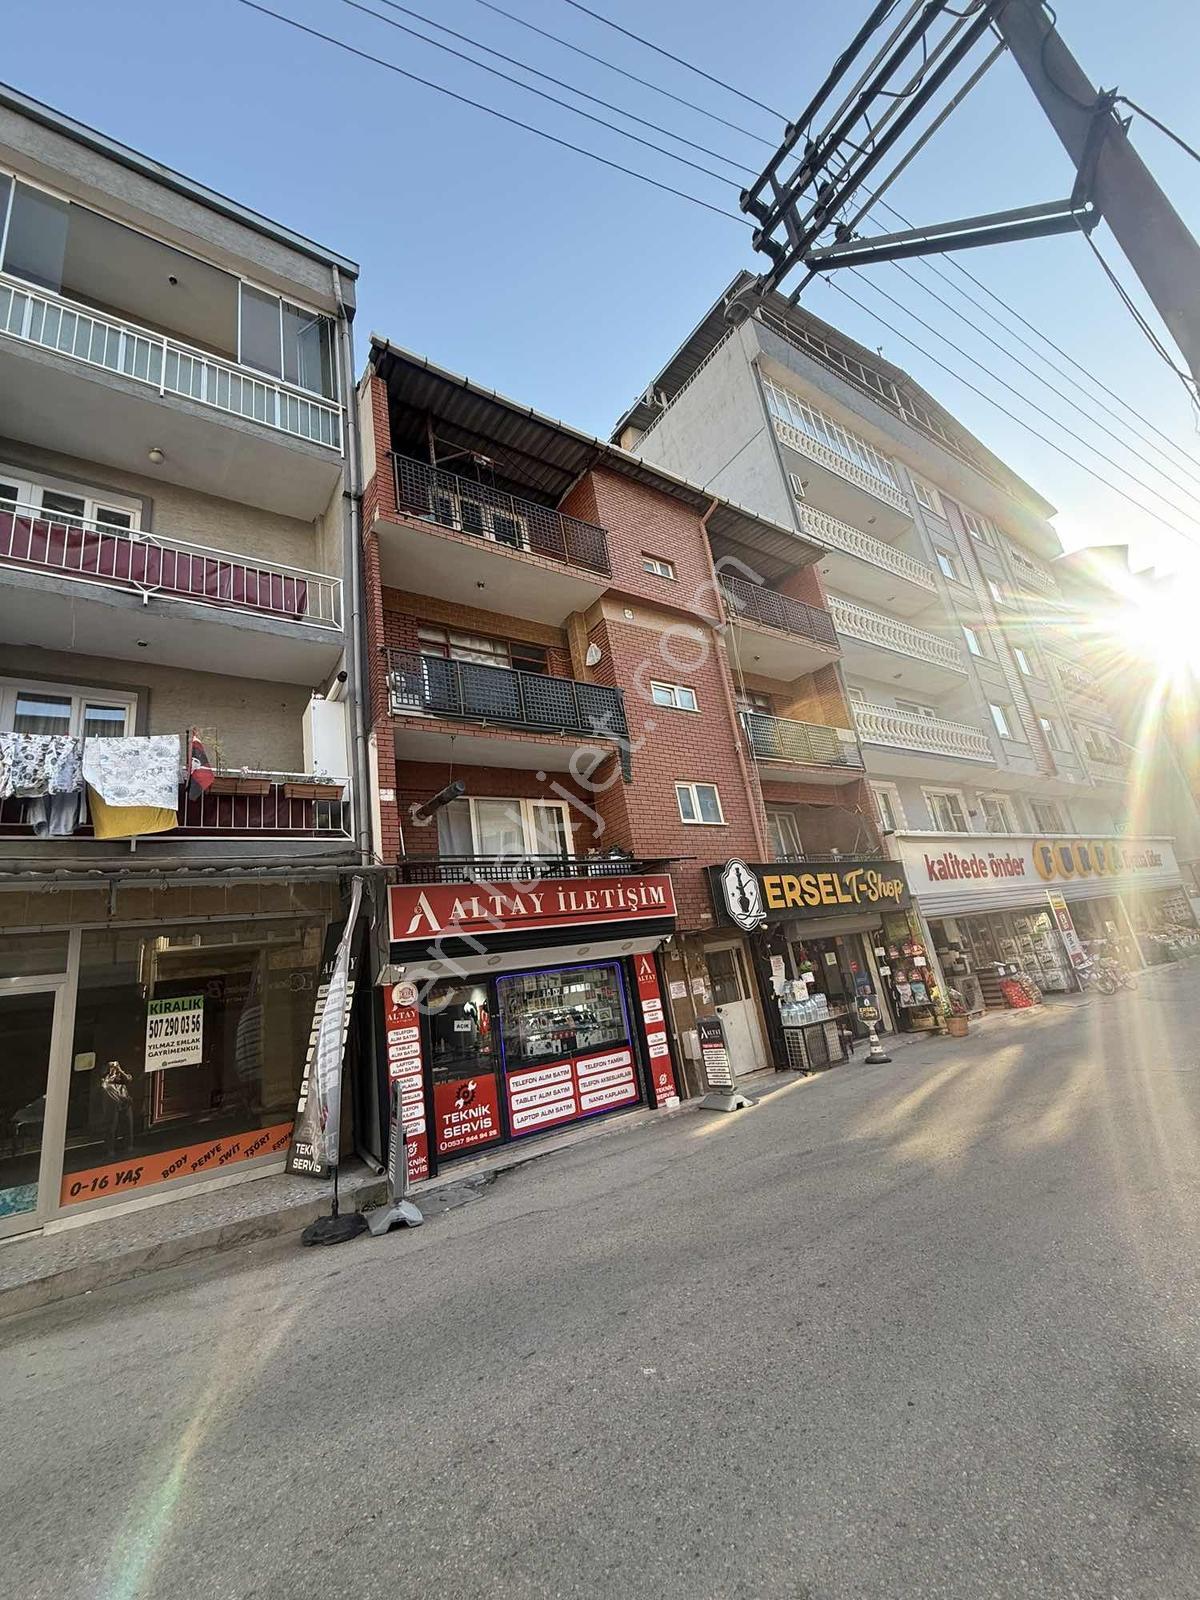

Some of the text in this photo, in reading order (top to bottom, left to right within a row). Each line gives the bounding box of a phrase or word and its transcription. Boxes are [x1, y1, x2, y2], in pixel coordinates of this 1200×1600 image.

[924, 852, 1025, 881] kalitede önder
[763, 868, 904, 909] ERSEL T-Shop
[449, 881, 667, 920] ALTAY İLETİŞİM
[322, 957, 358, 975] ALY
[150, 999, 201, 1015] KİRALIK
[387, 1010, 416, 1021] ALTAY
[149, 1013, 201, 1039] 507 290 03 56
[147, 1037, 201, 1051] YILMAZ EMLAK
[147, 1045, 201, 1058] GAYRİMENKUL
[585, 1061, 607, 1070] TELEFON
[511, 1069, 570, 1087] TELEFON ALIM SATIM
[580, 1079, 600, 1088] TELEFON
[515, 1086, 571, 1105] TABLET ALIM SATIM
[588, 1088, 629, 1104] NANO KAPLAMA
[442, 1104, 491, 1125] TEKNİK
[516, 1103, 573, 1124] LAPTOP ALIM SATIM
[443, 1117, 493, 1139] SERVİS
[190, 1143, 223, 1171] PENYE
[295, 1142, 315, 1156] TEKN
[161, 1154, 188, 1179] BODY
[408, 1156, 427, 1167] KNİK
[408, 1164, 428, 1176] RVİS
[70, 1166, 144, 1197] 0-16 YAŞ
